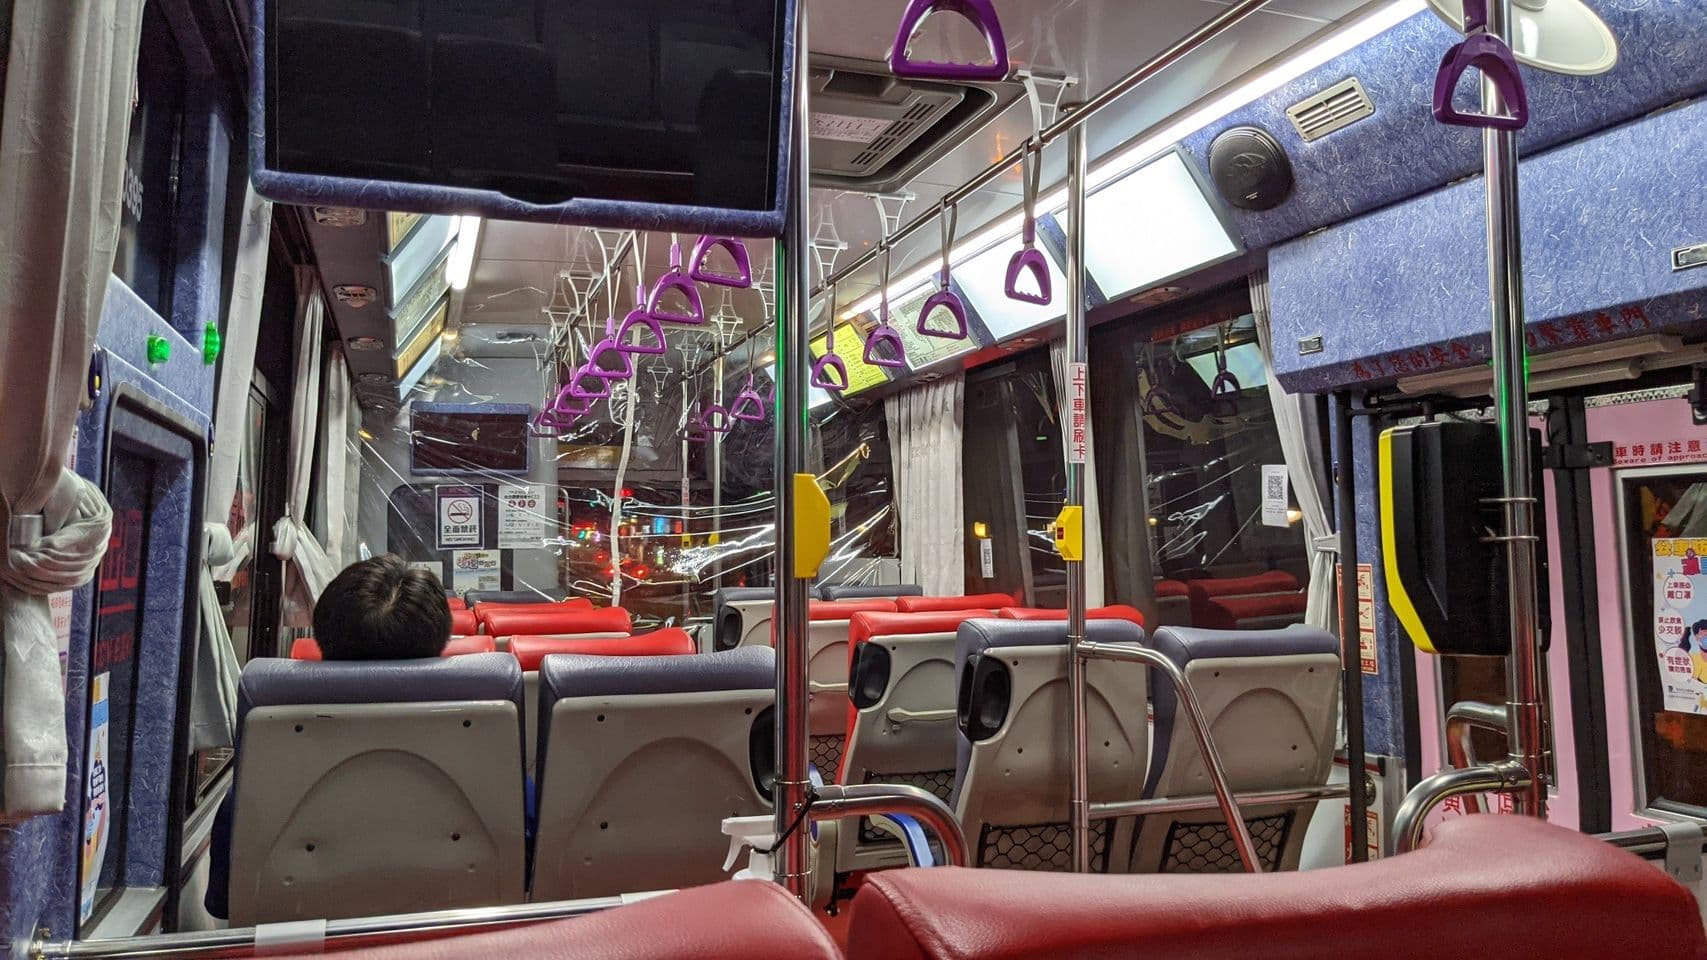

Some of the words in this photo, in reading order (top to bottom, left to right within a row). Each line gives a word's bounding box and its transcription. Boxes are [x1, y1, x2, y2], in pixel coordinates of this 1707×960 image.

[1072, 366, 1086, 459] 上下車請刷卡
[1615, 440, 1702, 458] 車時請注意
